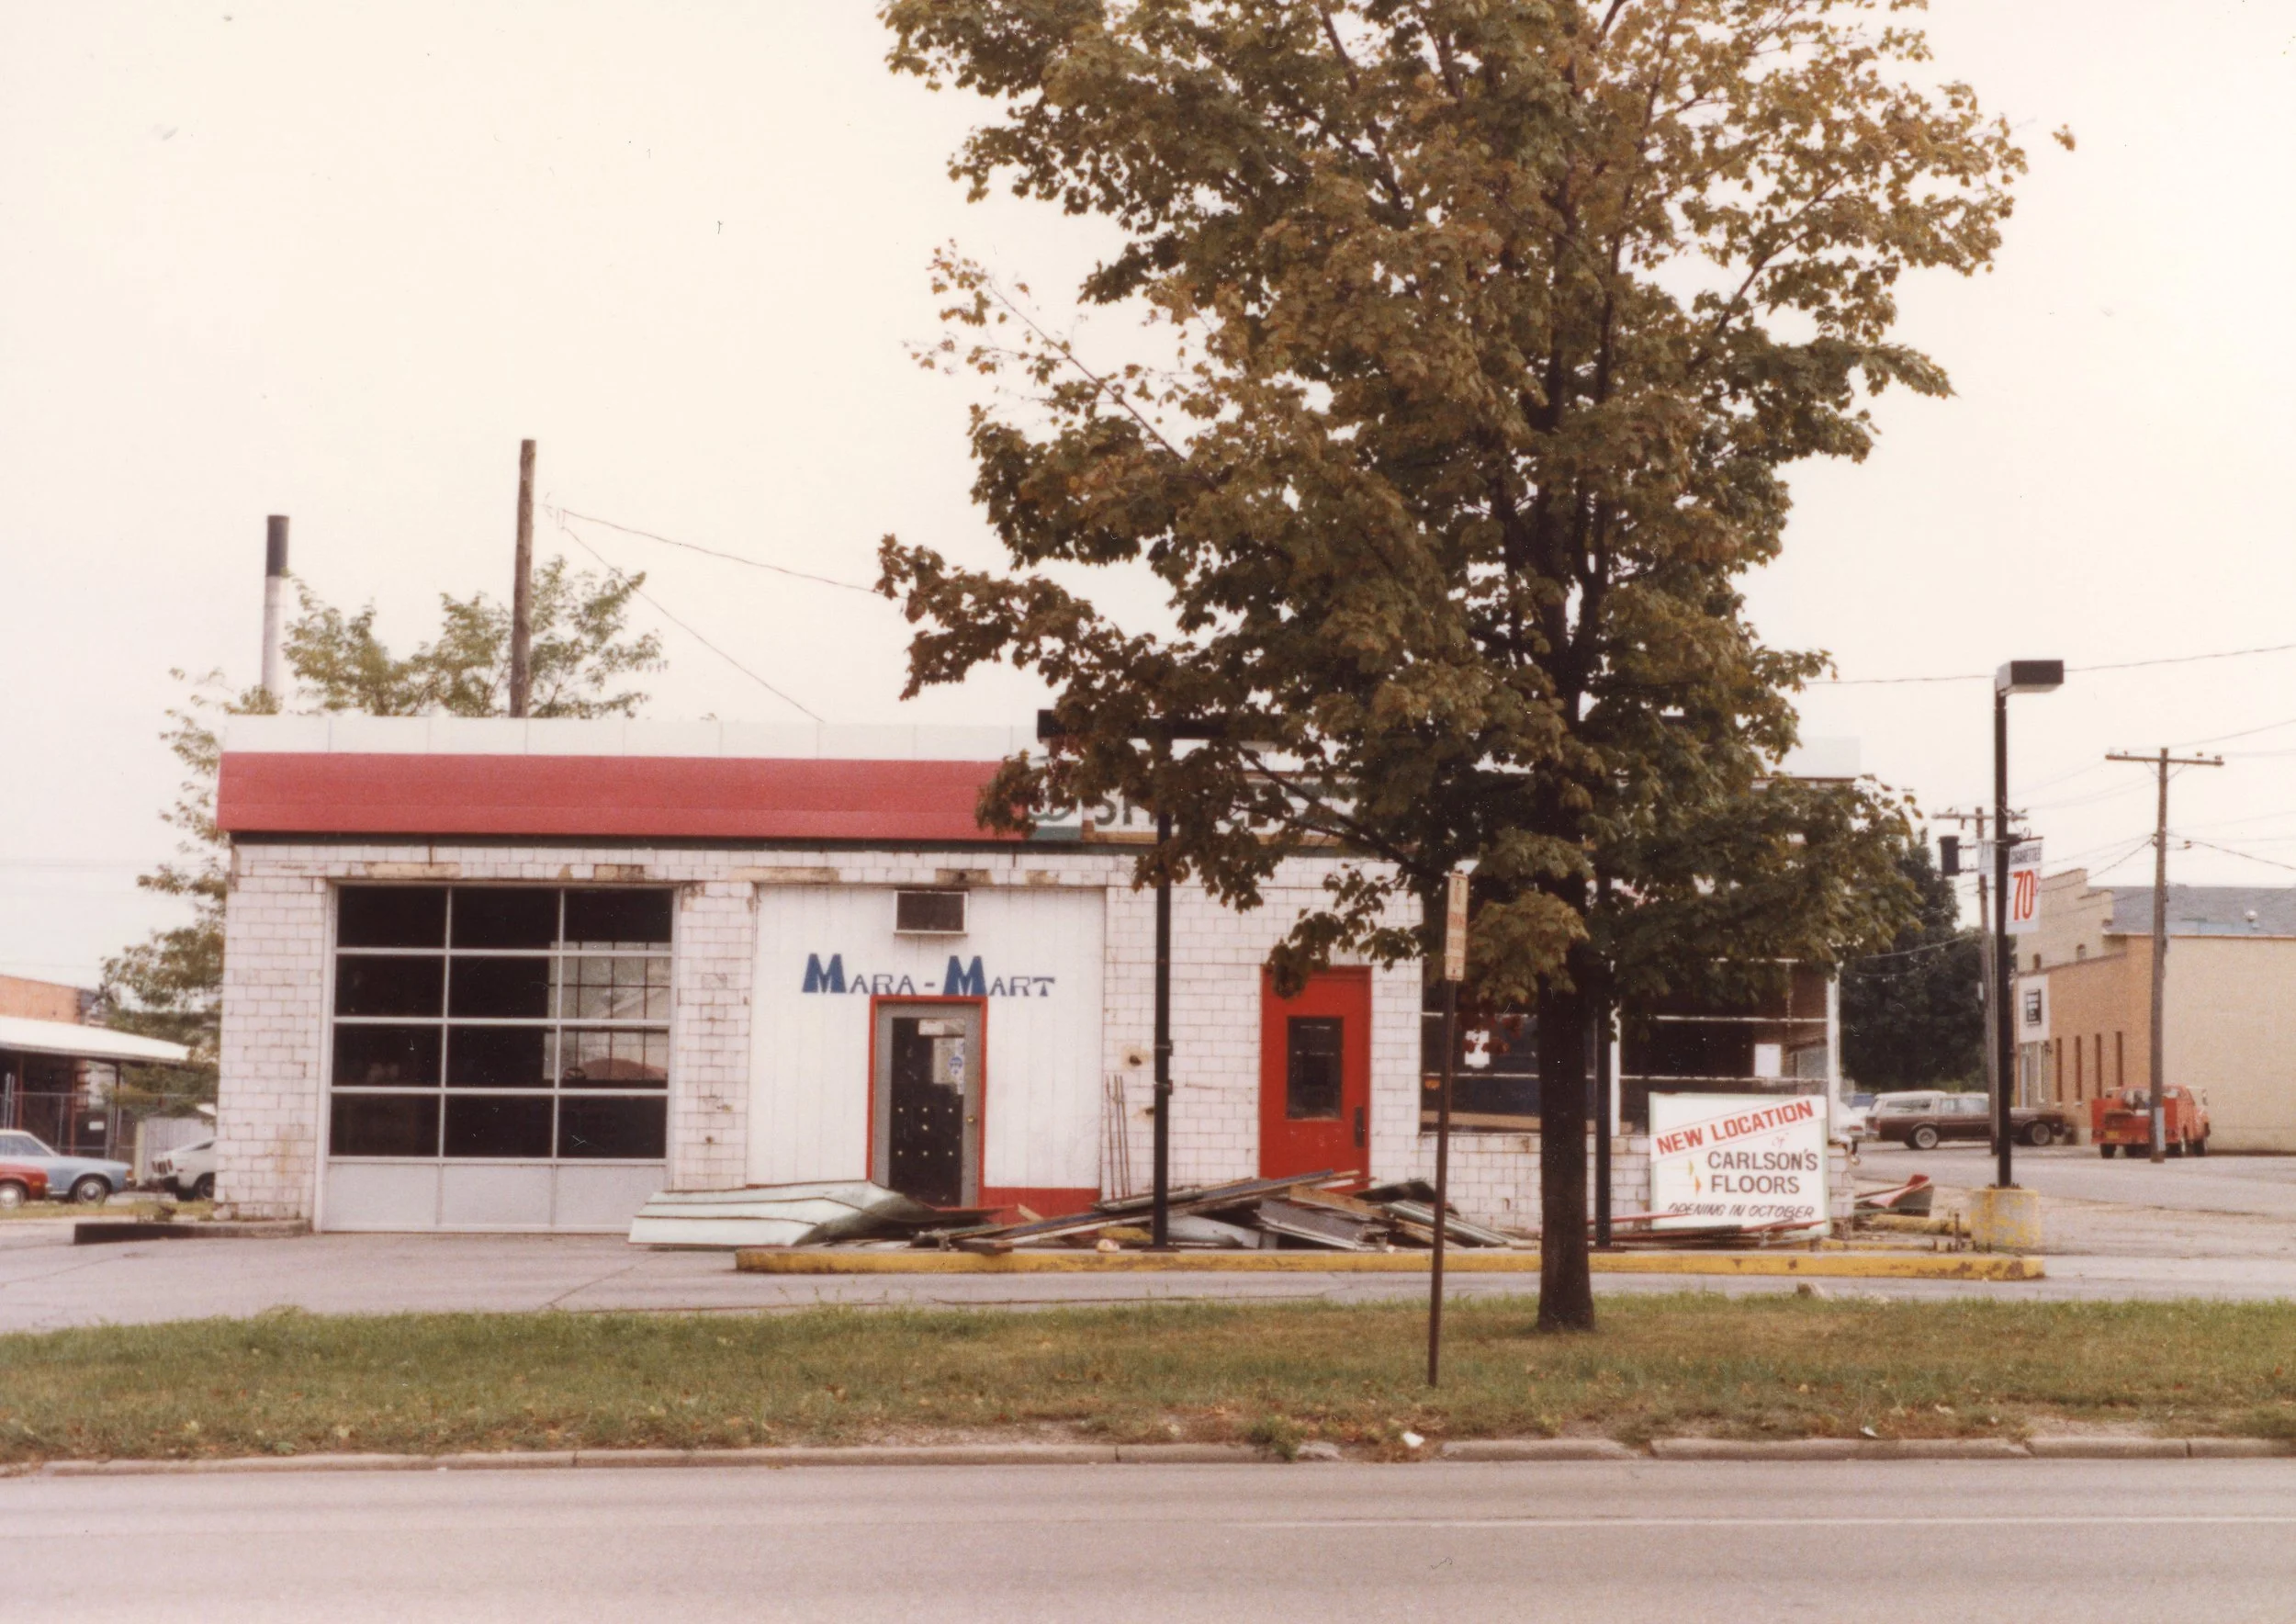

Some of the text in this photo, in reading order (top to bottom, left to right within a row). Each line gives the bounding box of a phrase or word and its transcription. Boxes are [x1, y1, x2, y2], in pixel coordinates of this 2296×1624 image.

[1657, 1100, 1815, 1156] NEW LOCATION
[1707, 1148, 1818, 1171] CARLSON'S
[1711, 1175, 1801, 1194] FLOORS
[1668, 1202, 1815, 1219] OPENING IN OCTOBER
